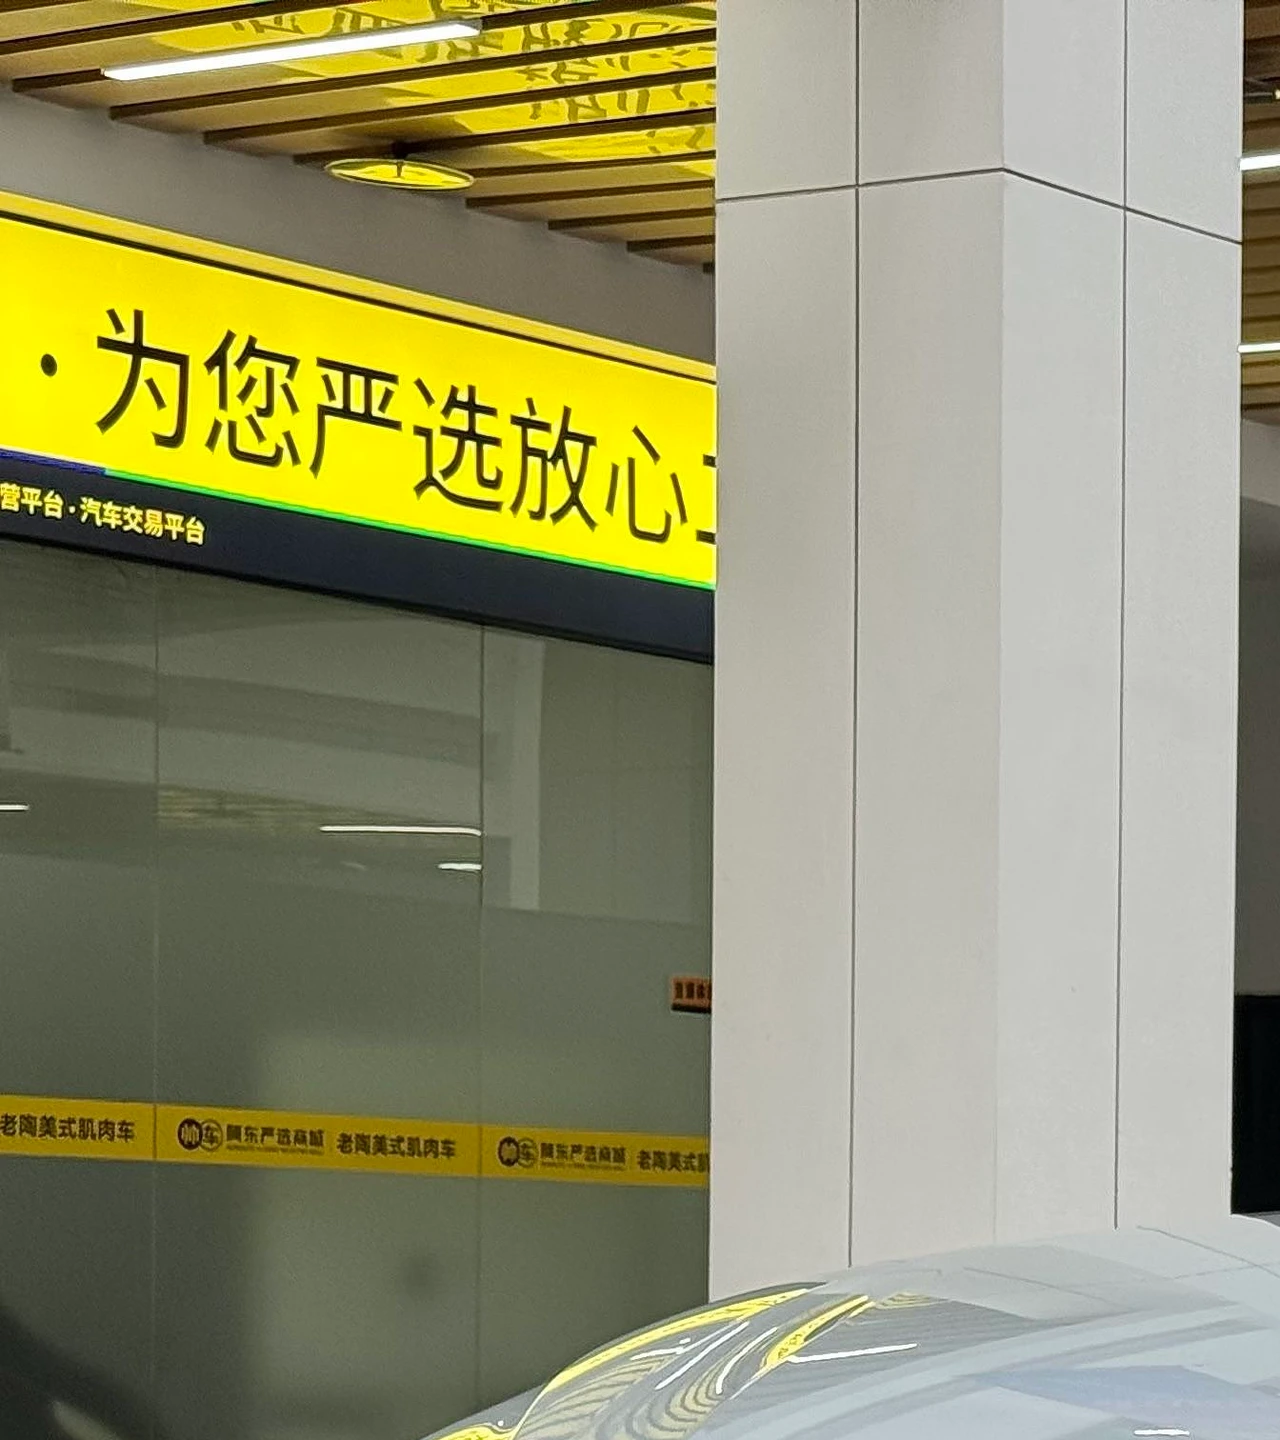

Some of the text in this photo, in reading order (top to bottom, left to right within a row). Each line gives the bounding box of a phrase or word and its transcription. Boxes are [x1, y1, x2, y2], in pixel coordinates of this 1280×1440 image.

[40, 308, 716, 545] ·为您严选放心
[0, 1113, 136, 1144] 老陶美式肌肉车
[337, 1132, 457, 1158] 老陶美式肌肉车
